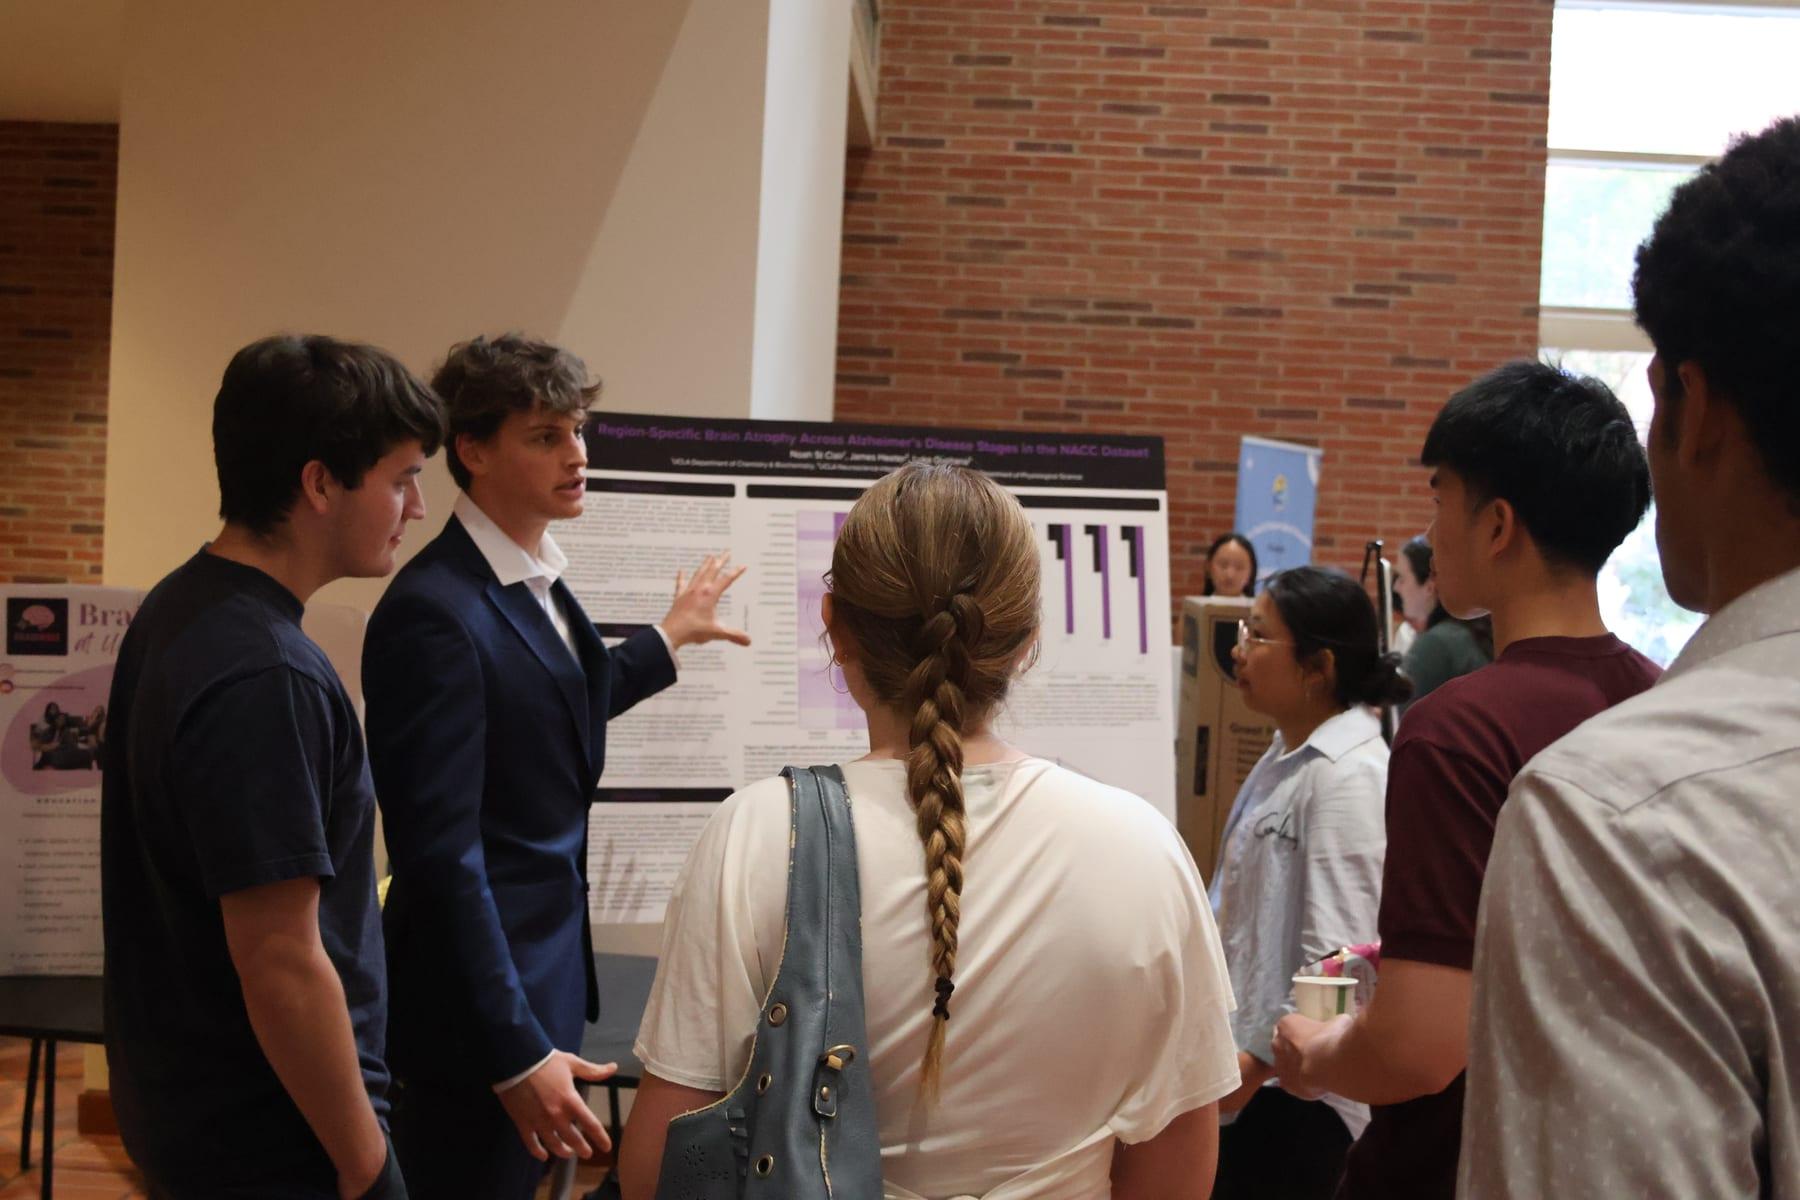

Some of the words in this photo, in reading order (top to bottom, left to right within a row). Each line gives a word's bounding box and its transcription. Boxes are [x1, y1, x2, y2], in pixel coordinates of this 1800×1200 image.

[598, 424, 701, 440] Region-Specific
[705, 429, 739, 441] Brain
[744, 431, 797, 445] Atrophy
[800, 433, 844, 445] Across
[848, 434, 922, 448] Alzheimer's
[925, 437, 973, 450] Disease
[976, 440, 1018, 455] Stages
[1022, 442, 1033, 454] in
[1036, 443, 1057, 455] the
[1060, 445, 1097, 457] NACC
[1101, 446, 1149, 459] Dataset
